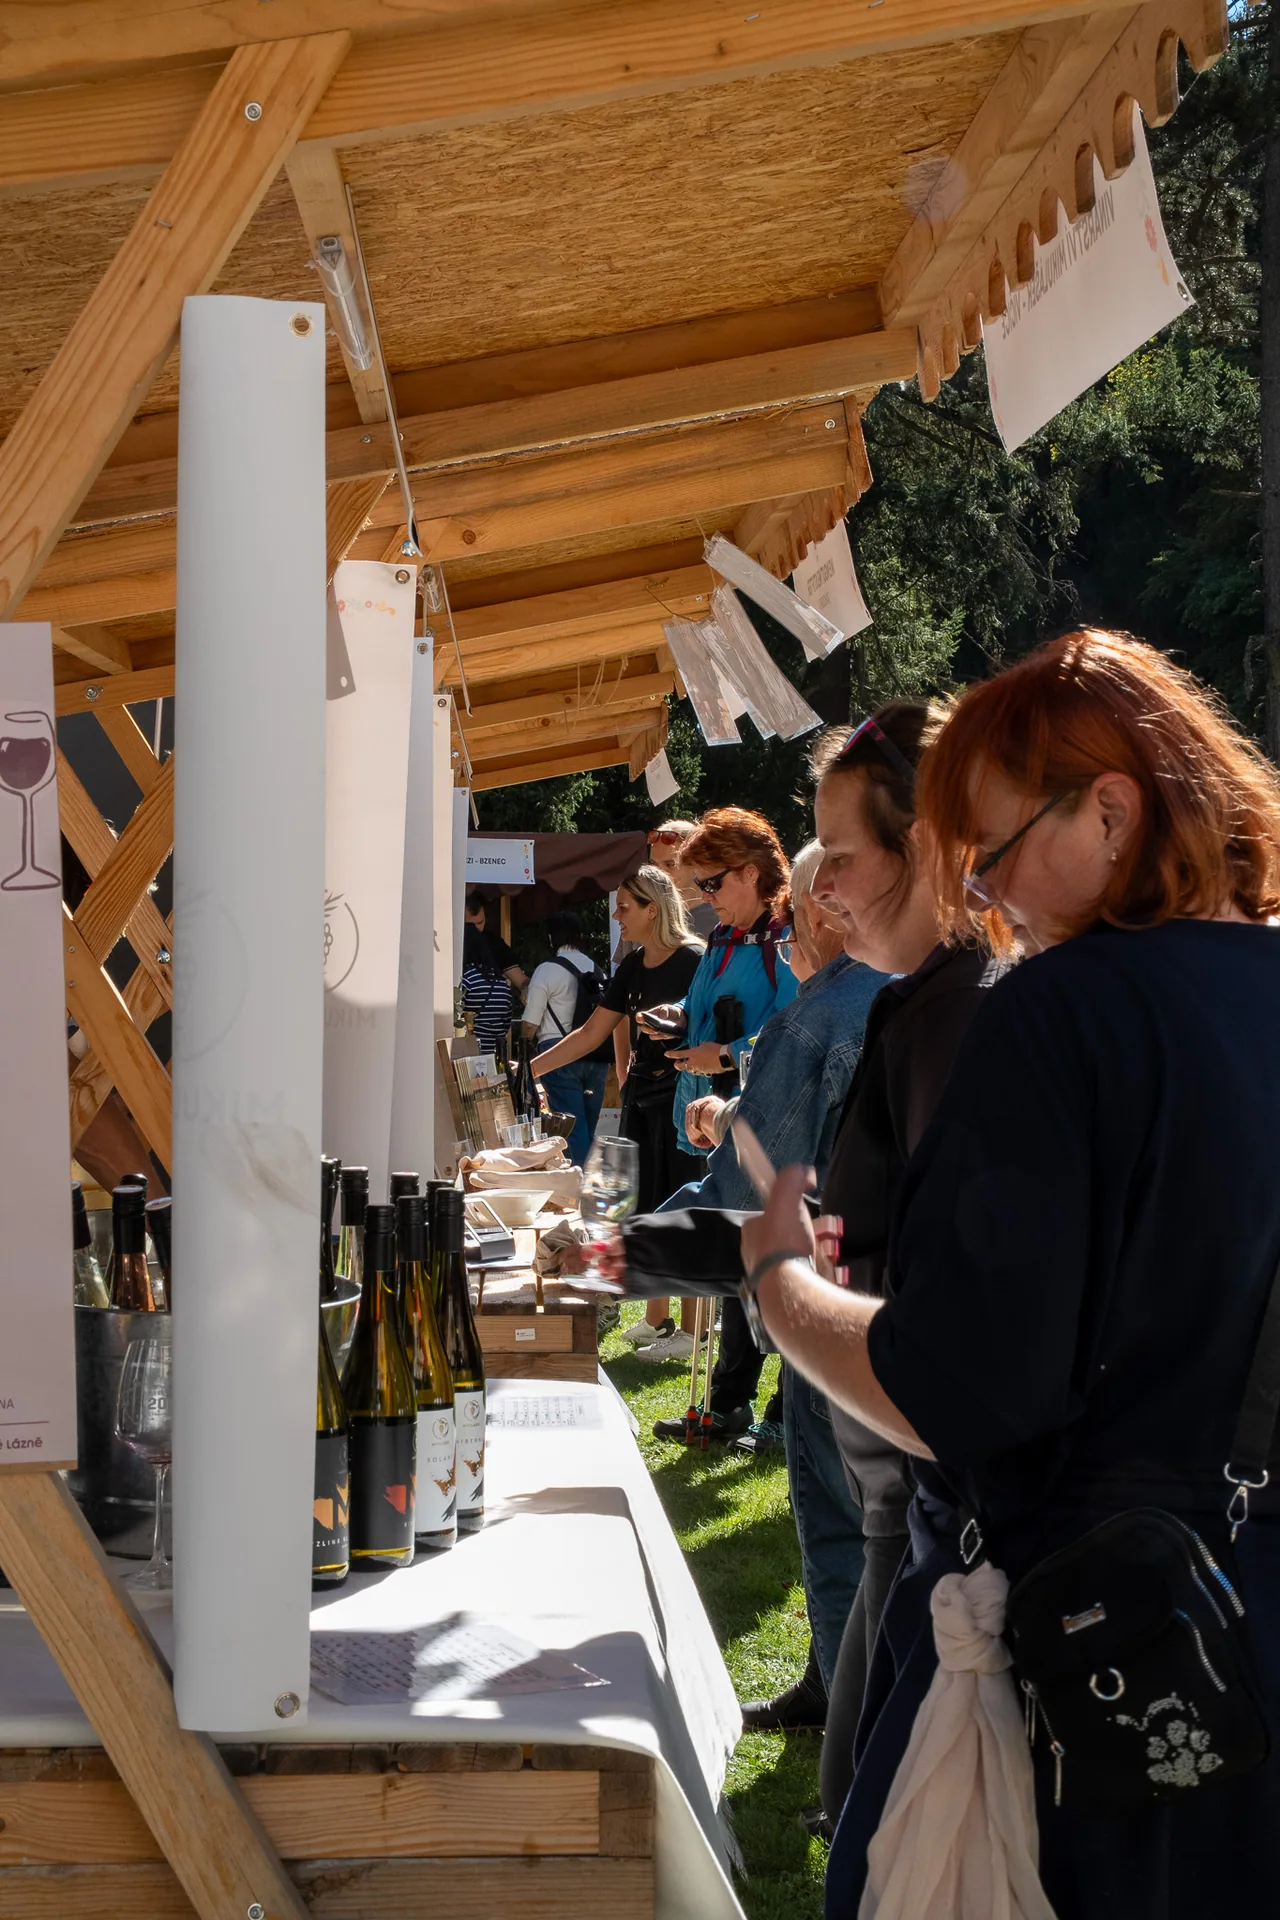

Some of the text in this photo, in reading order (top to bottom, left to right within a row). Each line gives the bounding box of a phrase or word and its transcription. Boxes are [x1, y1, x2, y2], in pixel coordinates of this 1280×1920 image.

[479, 857, 506, 865] BZENEC
[0, 1398, 14, 1409] NA
[6, 1437, 43, 1450] Lázně
